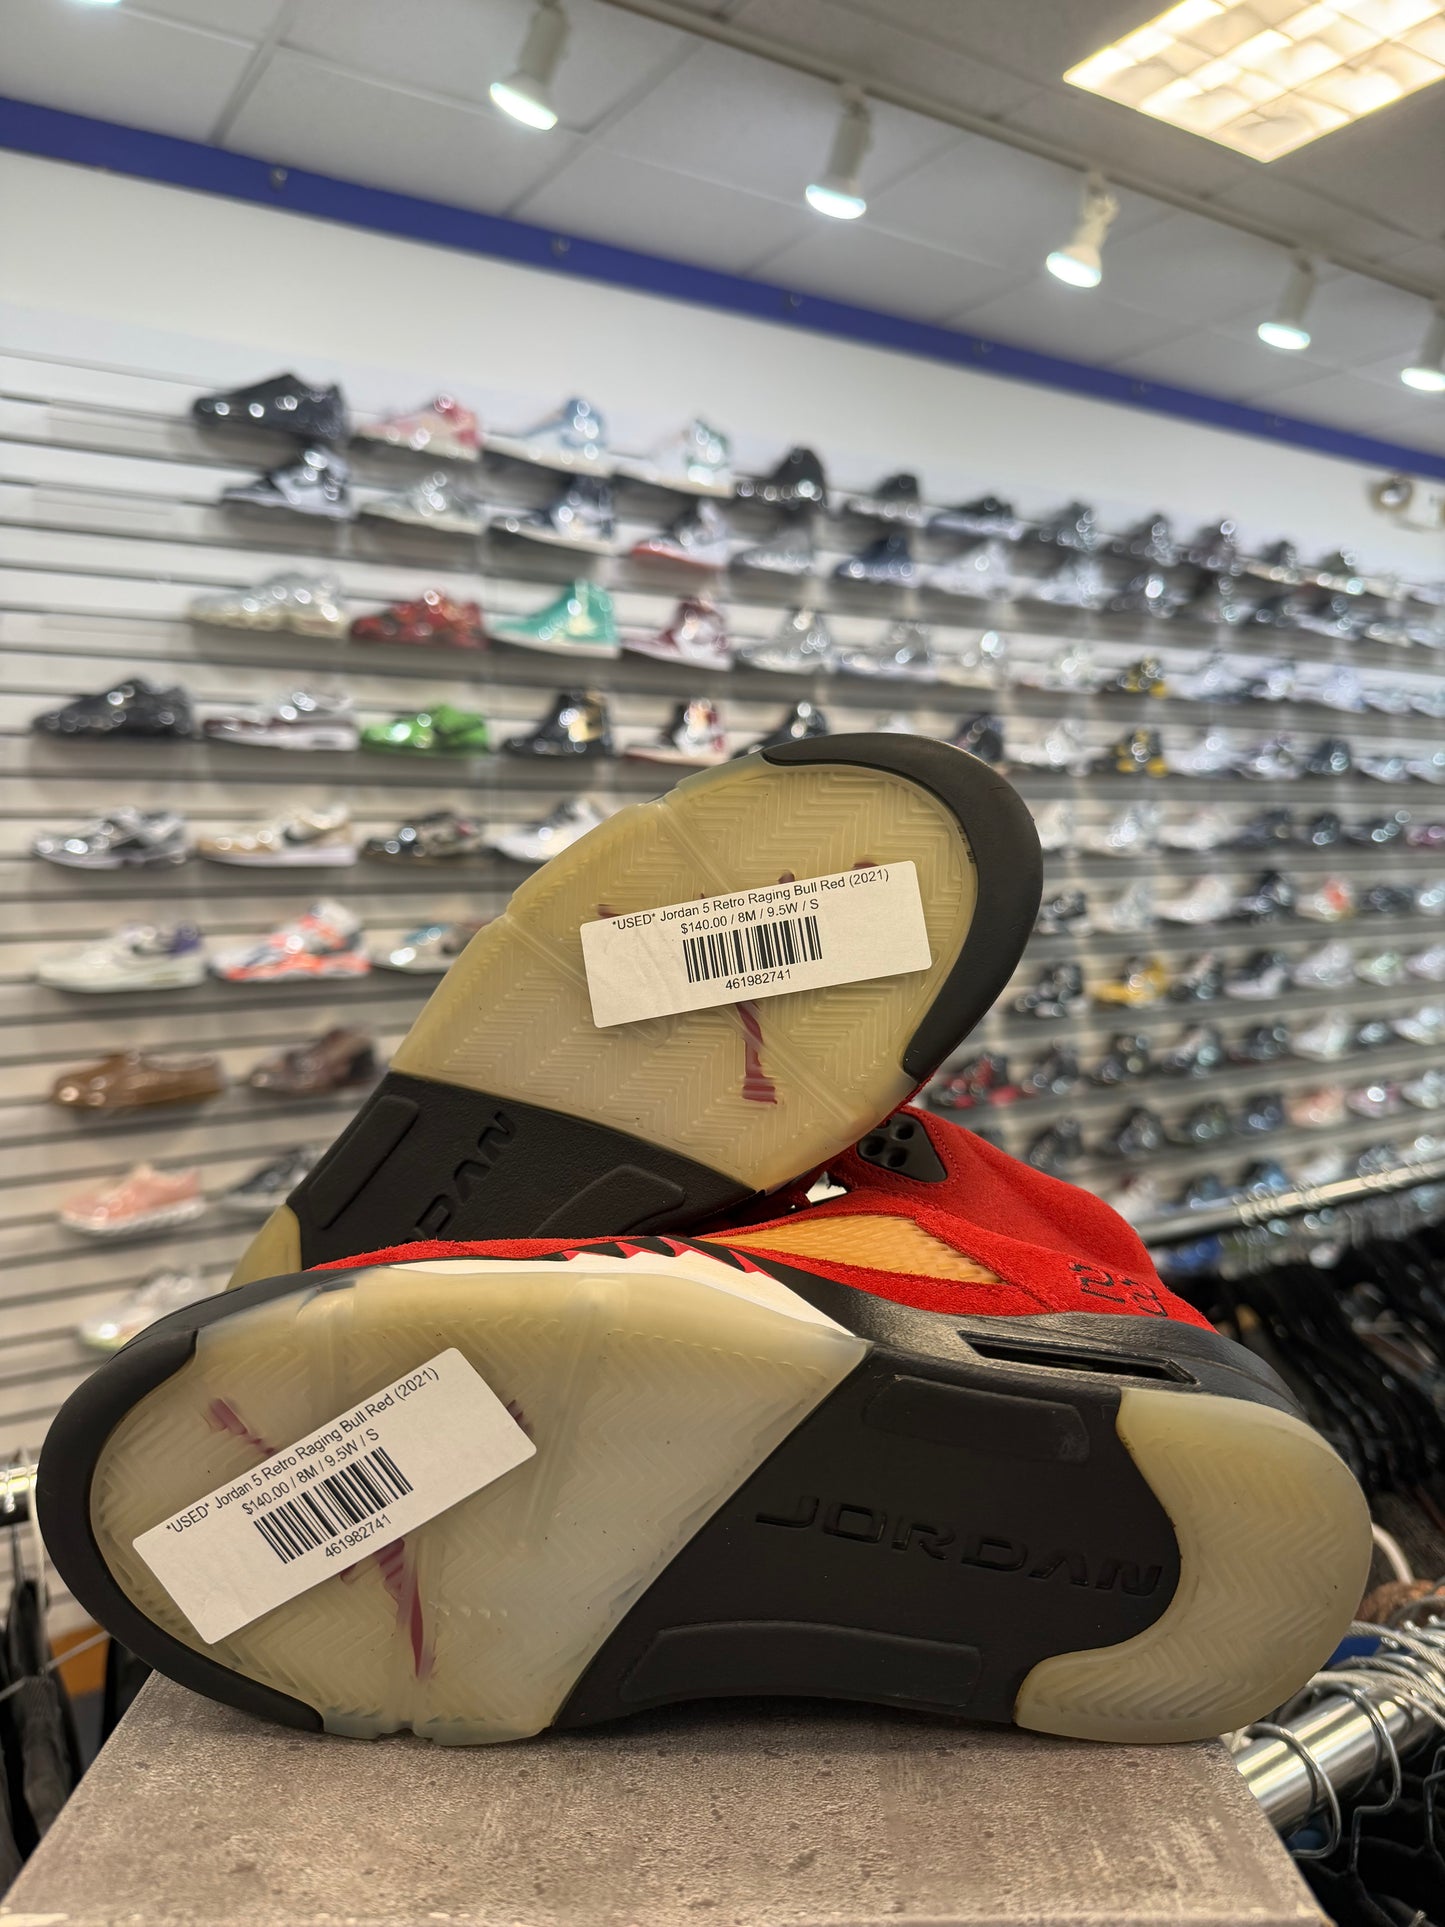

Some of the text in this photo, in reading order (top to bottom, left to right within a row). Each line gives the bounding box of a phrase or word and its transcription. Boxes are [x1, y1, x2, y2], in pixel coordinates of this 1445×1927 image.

[659, 905, 700, 922] Jordan
[702, 901, 710, 914] 5
[713, 897, 745, 911] Retro
[748, 887, 791, 906] Raging
[793, 881, 818, 896] Bull
[820, 876, 845, 891] Red
[849, 869, 889, 888] (2021)
[681, 898, 819, 935] $140.00 / 8M / 9.5W / S
[725, 968, 792, 990] 461982741
[407, 1111, 517, 1241] DAN
[214, 1482, 254, 1510] Jordan
[251, 1473, 263, 1487] 5
[260, 1456, 297, 1481] Retro
[294, 1429, 343, 1462] Raging
[339, 1410, 368, 1434] Bull
[364, 1393, 395, 1417] Red
[394, 1367, 440, 1401] (2021)
[241, 1428, 380, 1516] $140.00 / 8M / 9.5W / S
[324, 1513, 393, 1558] 461982741
[755, 1495, 1163, 1597] JORDAN
